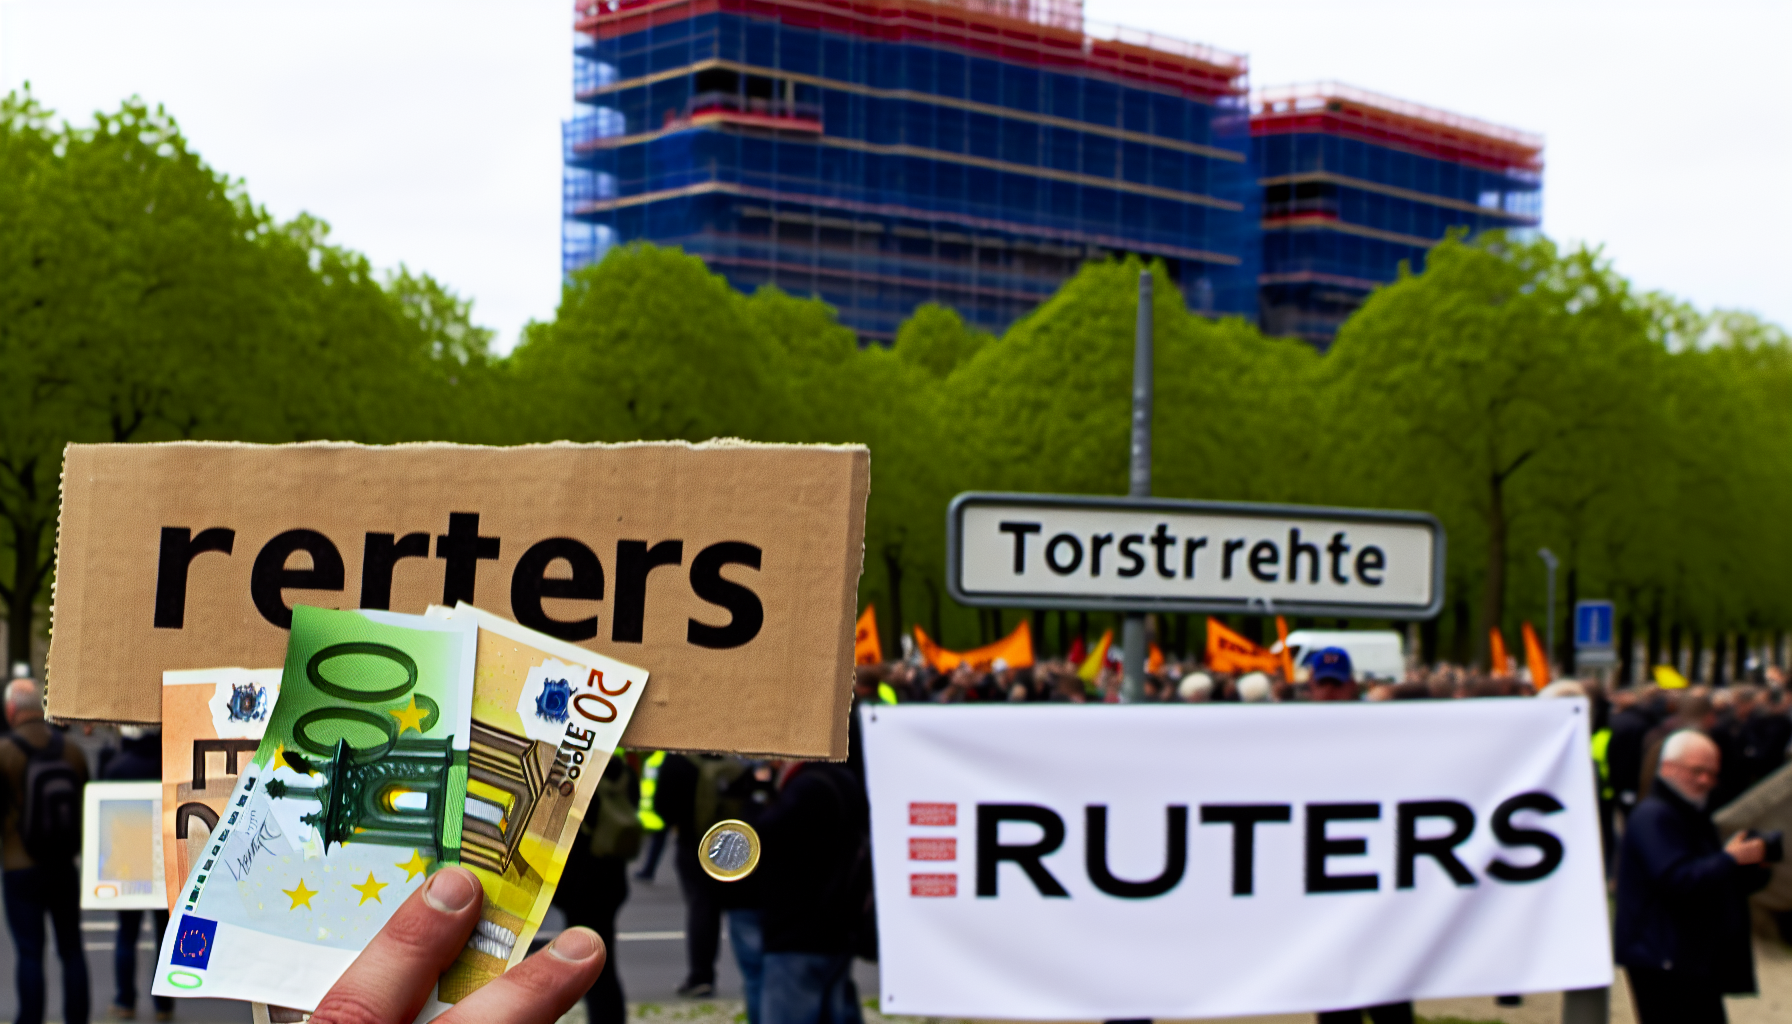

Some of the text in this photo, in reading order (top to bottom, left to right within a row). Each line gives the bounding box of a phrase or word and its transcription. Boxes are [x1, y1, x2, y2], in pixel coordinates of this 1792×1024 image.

[154, 512, 763, 649] rerters
[1000, 522, 1387, 586] Torstr rehte
[975, 791, 1566, 899] RUTERS
